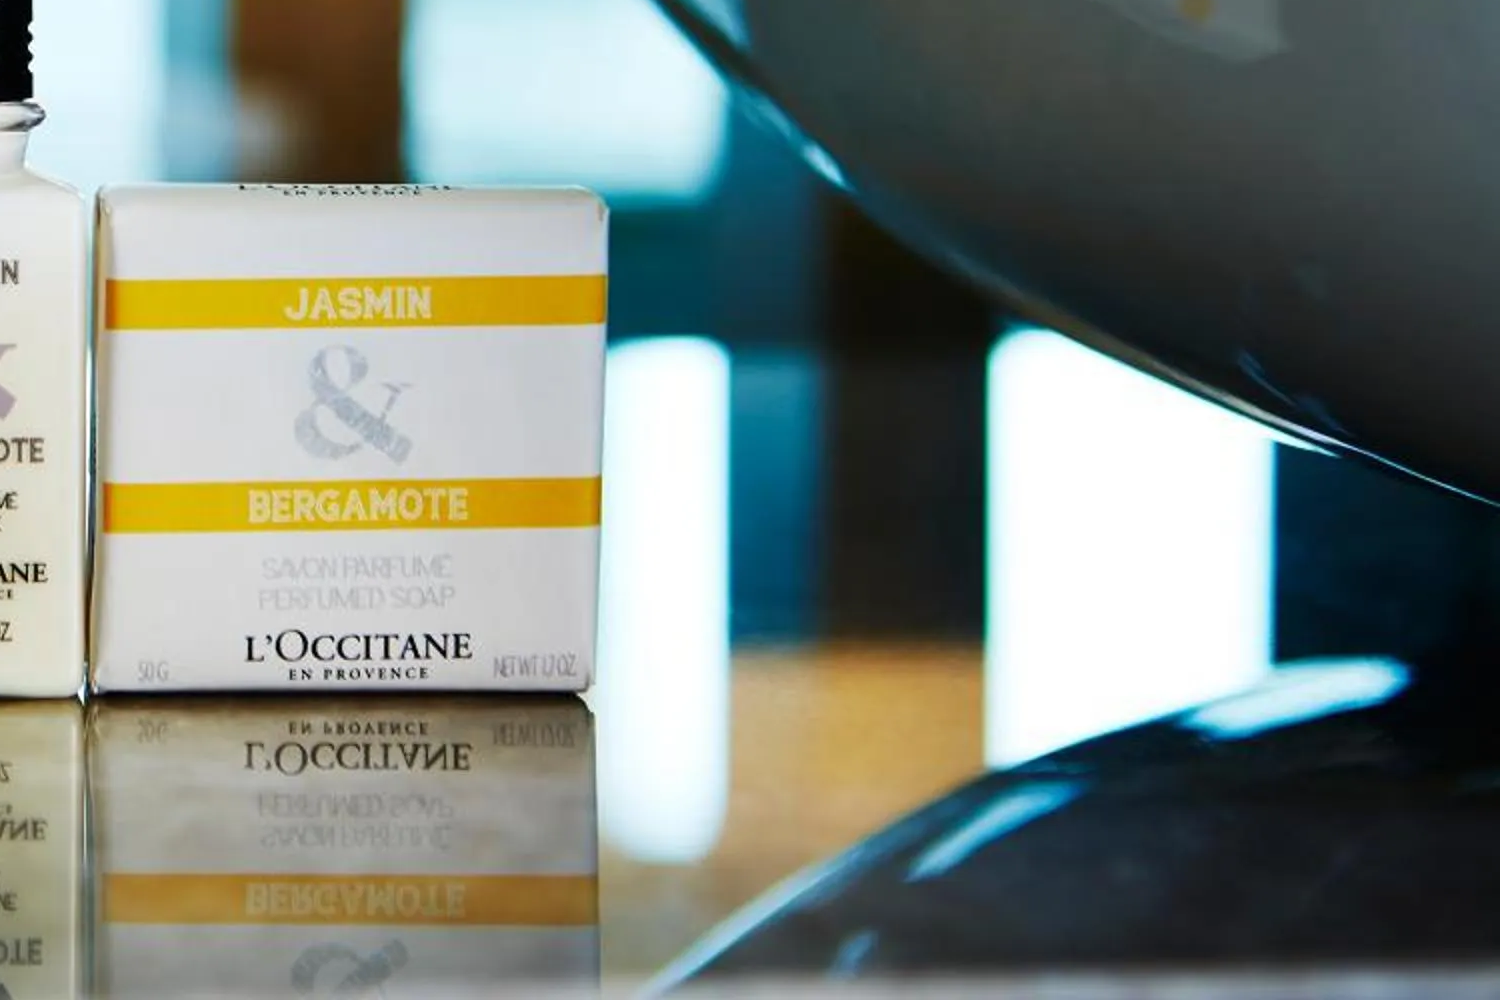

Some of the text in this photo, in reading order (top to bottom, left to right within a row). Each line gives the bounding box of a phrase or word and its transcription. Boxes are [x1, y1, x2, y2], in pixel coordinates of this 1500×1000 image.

[285, 286, 433, 321] JASMIN
[294, 343, 415, 465] &
[248, 487, 469, 524] BERGAMOTE
[261, 556, 337, 581] SAVON
[258, 585, 456, 611] PERFUMED SOAP
[244, 629, 473, 663] L'OCCITANE
[288, 667, 430, 681] EN PROVENCE
